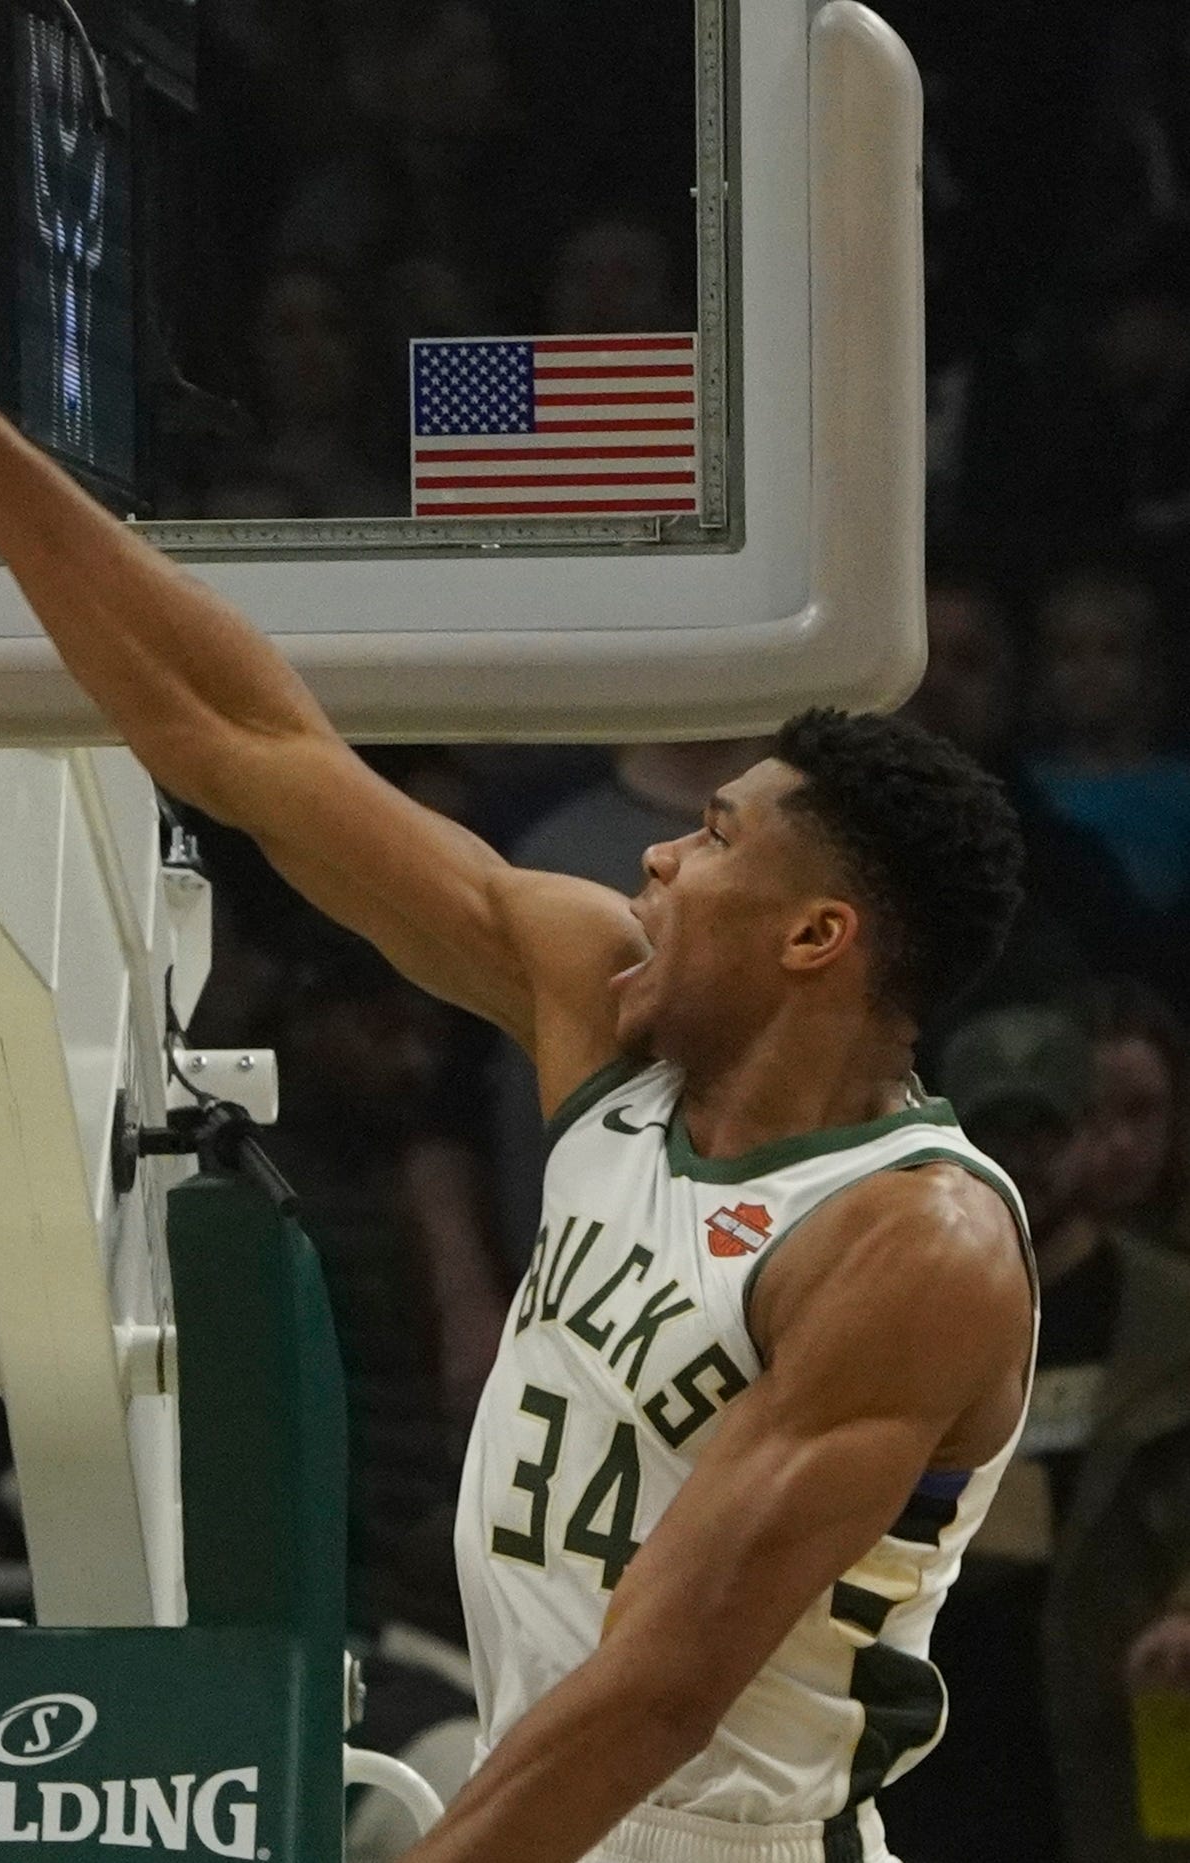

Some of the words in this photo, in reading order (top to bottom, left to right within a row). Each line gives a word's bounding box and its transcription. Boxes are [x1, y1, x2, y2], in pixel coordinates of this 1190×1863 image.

[515, 1216, 750, 1449] BUCKS
[491, 1383, 642, 1591] 34
[23, 1705, 60, 1754] S
